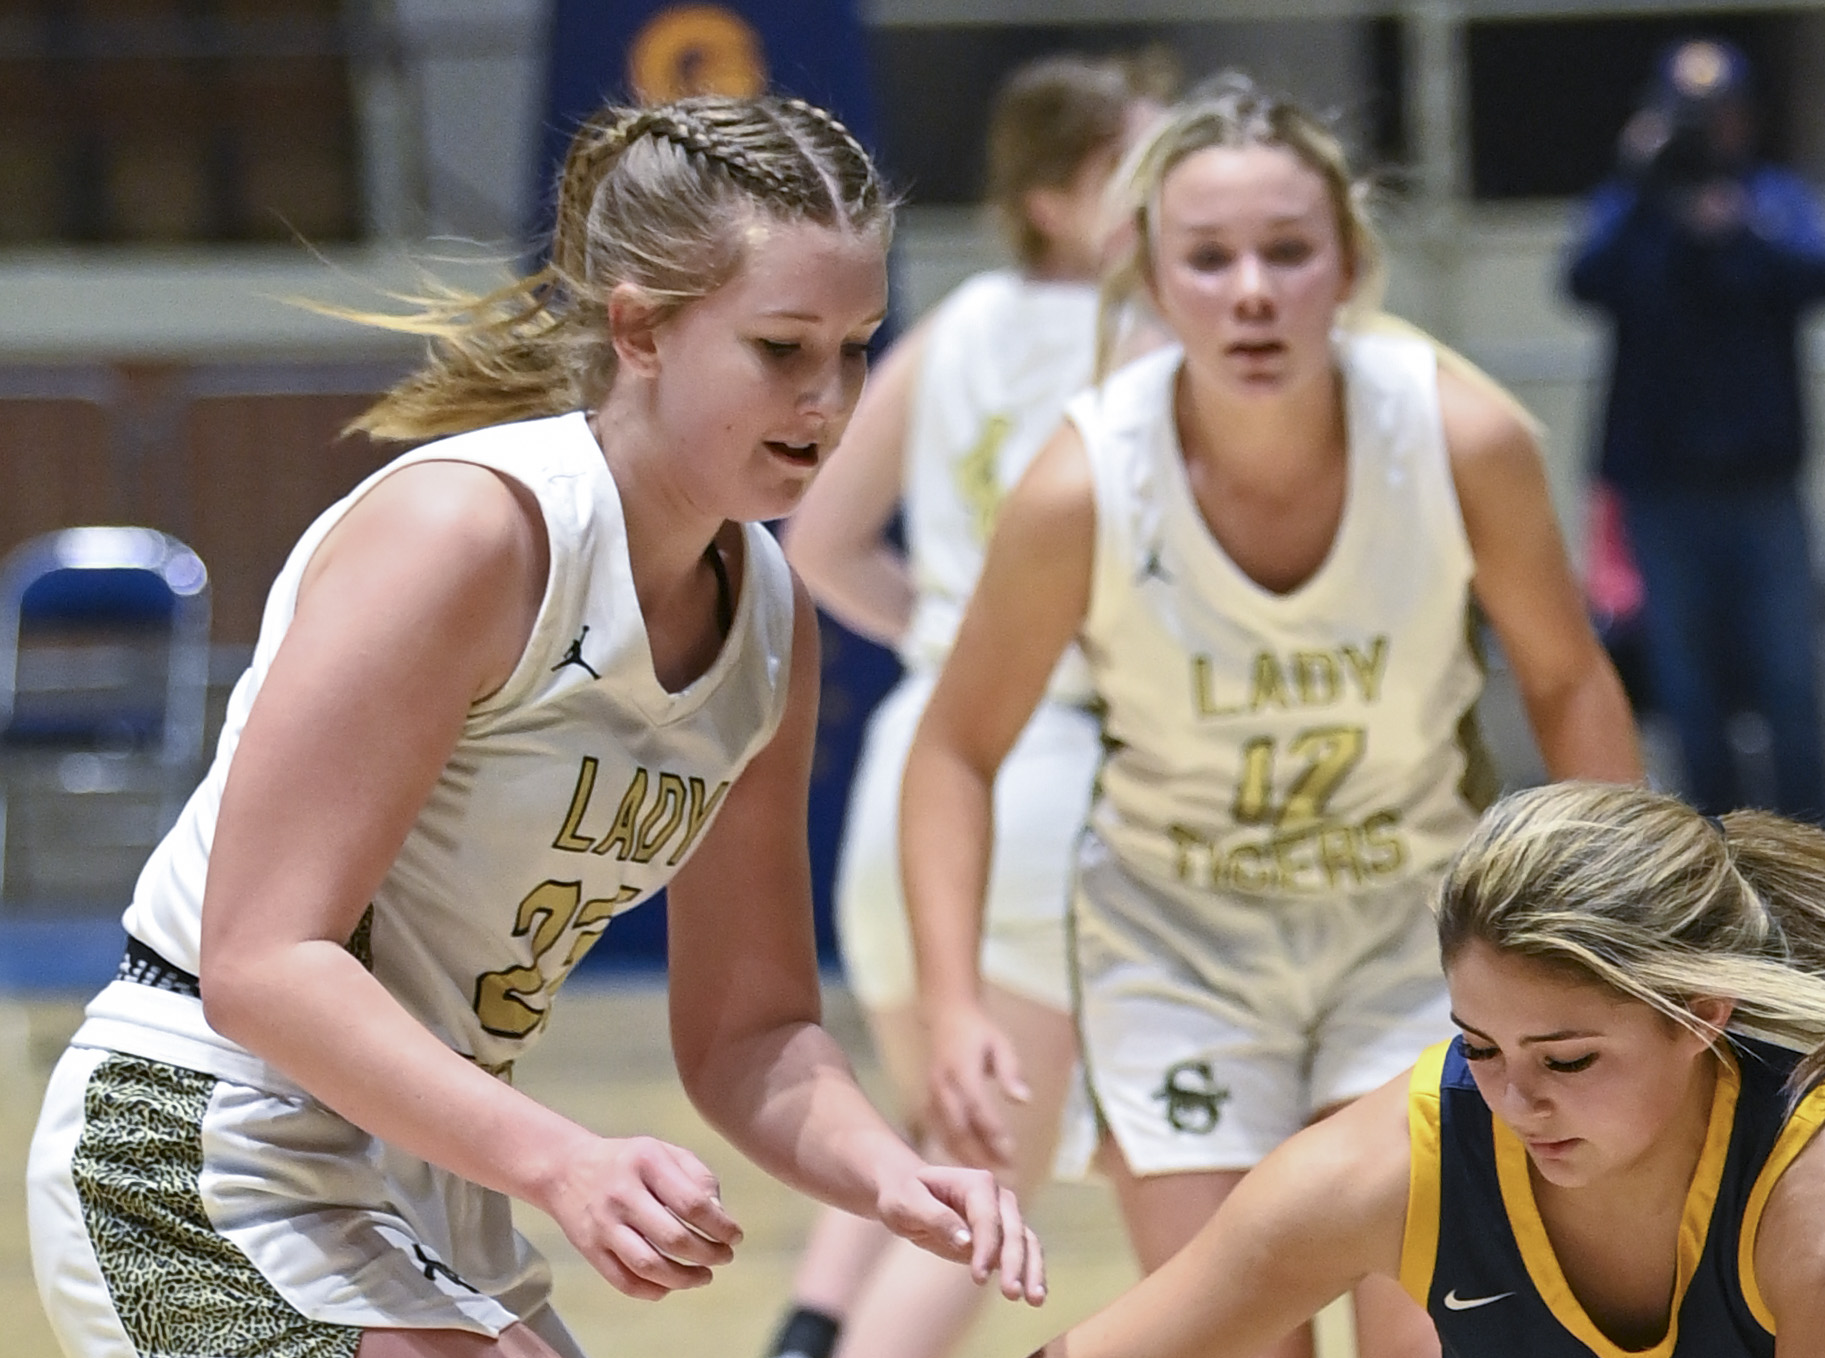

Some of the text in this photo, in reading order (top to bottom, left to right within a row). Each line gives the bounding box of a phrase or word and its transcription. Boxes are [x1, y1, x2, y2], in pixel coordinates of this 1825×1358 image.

[1191, 633, 1389, 718] LADY
[552, 755, 730, 867] LADY
[1167, 809, 1409, 890] TIGERS
